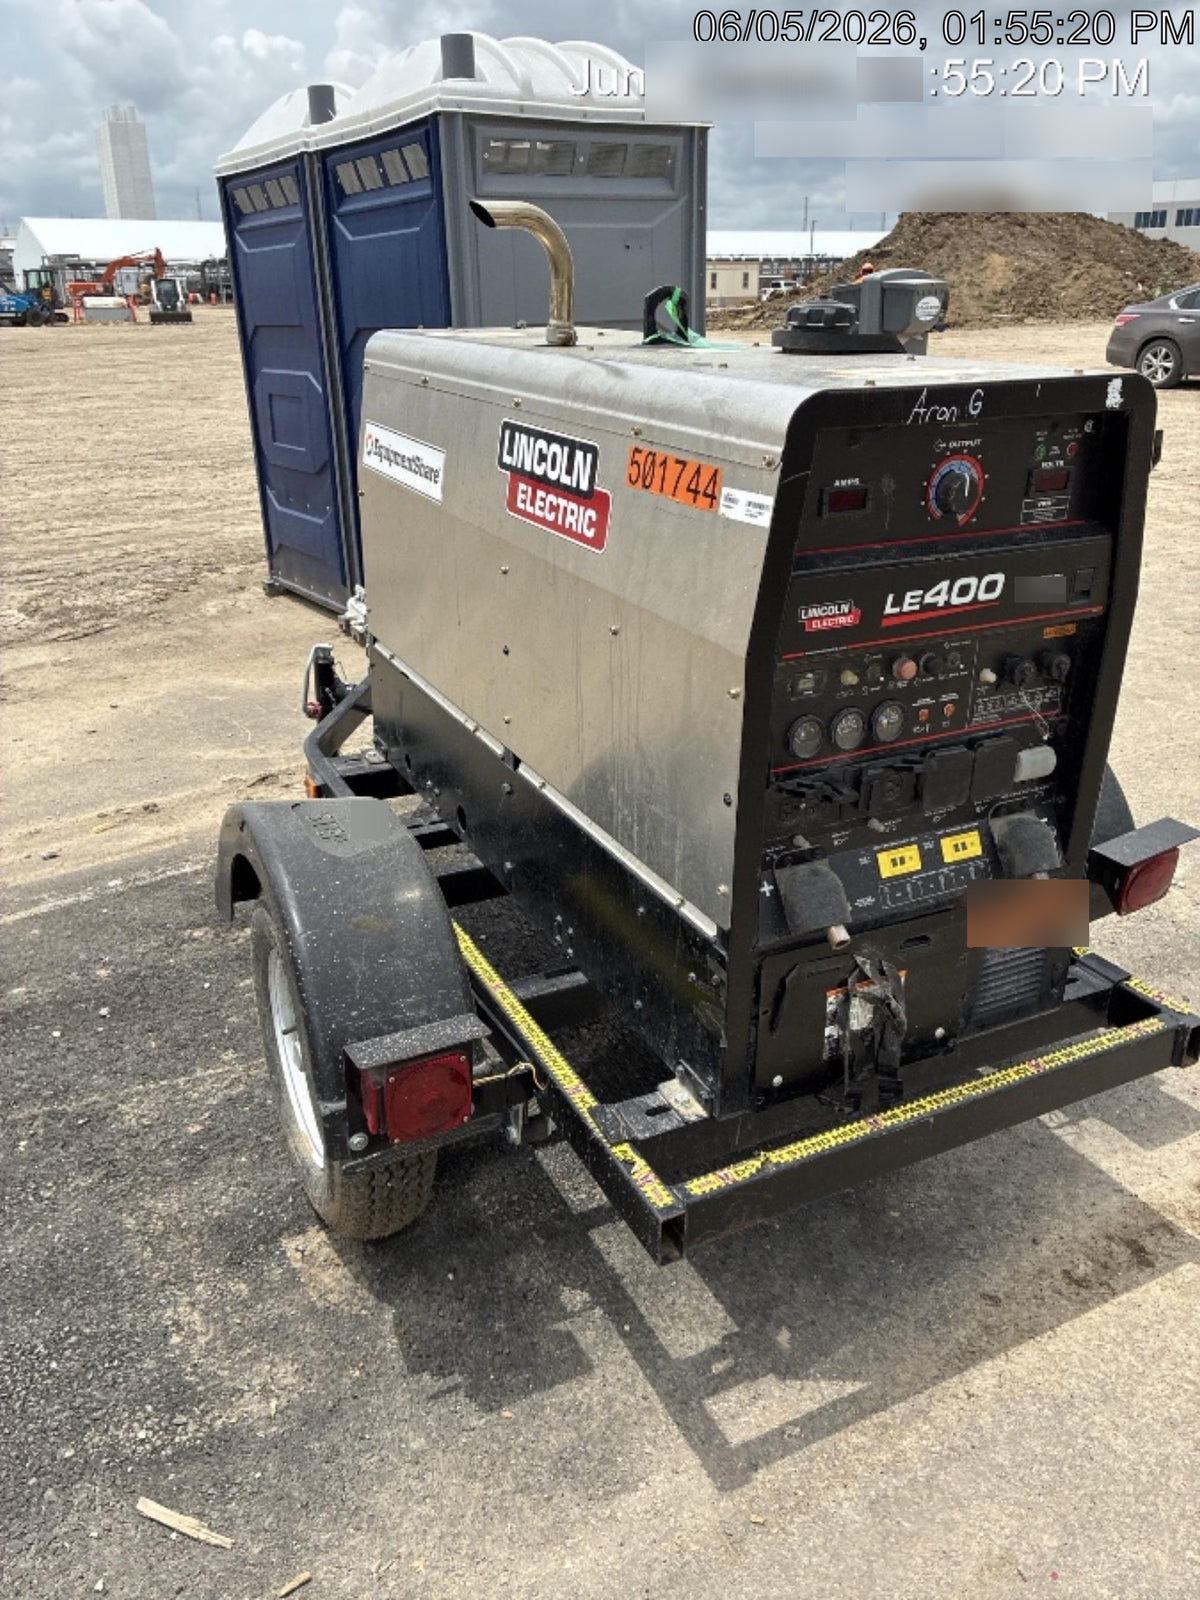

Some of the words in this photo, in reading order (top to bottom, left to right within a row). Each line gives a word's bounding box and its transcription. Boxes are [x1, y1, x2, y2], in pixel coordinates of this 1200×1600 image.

[968, 388, 984, 415] G
[502, 429, 592, 491] LINCOLN
[628, 447, 719, 509] 501744
[517, 482, 597, 538] ELECTRIC
[801, 604, 849, 619] LINCOLN
[884, 573, 1005, 614] LE400
[812, 615, 854, 628] ELECTRIC
